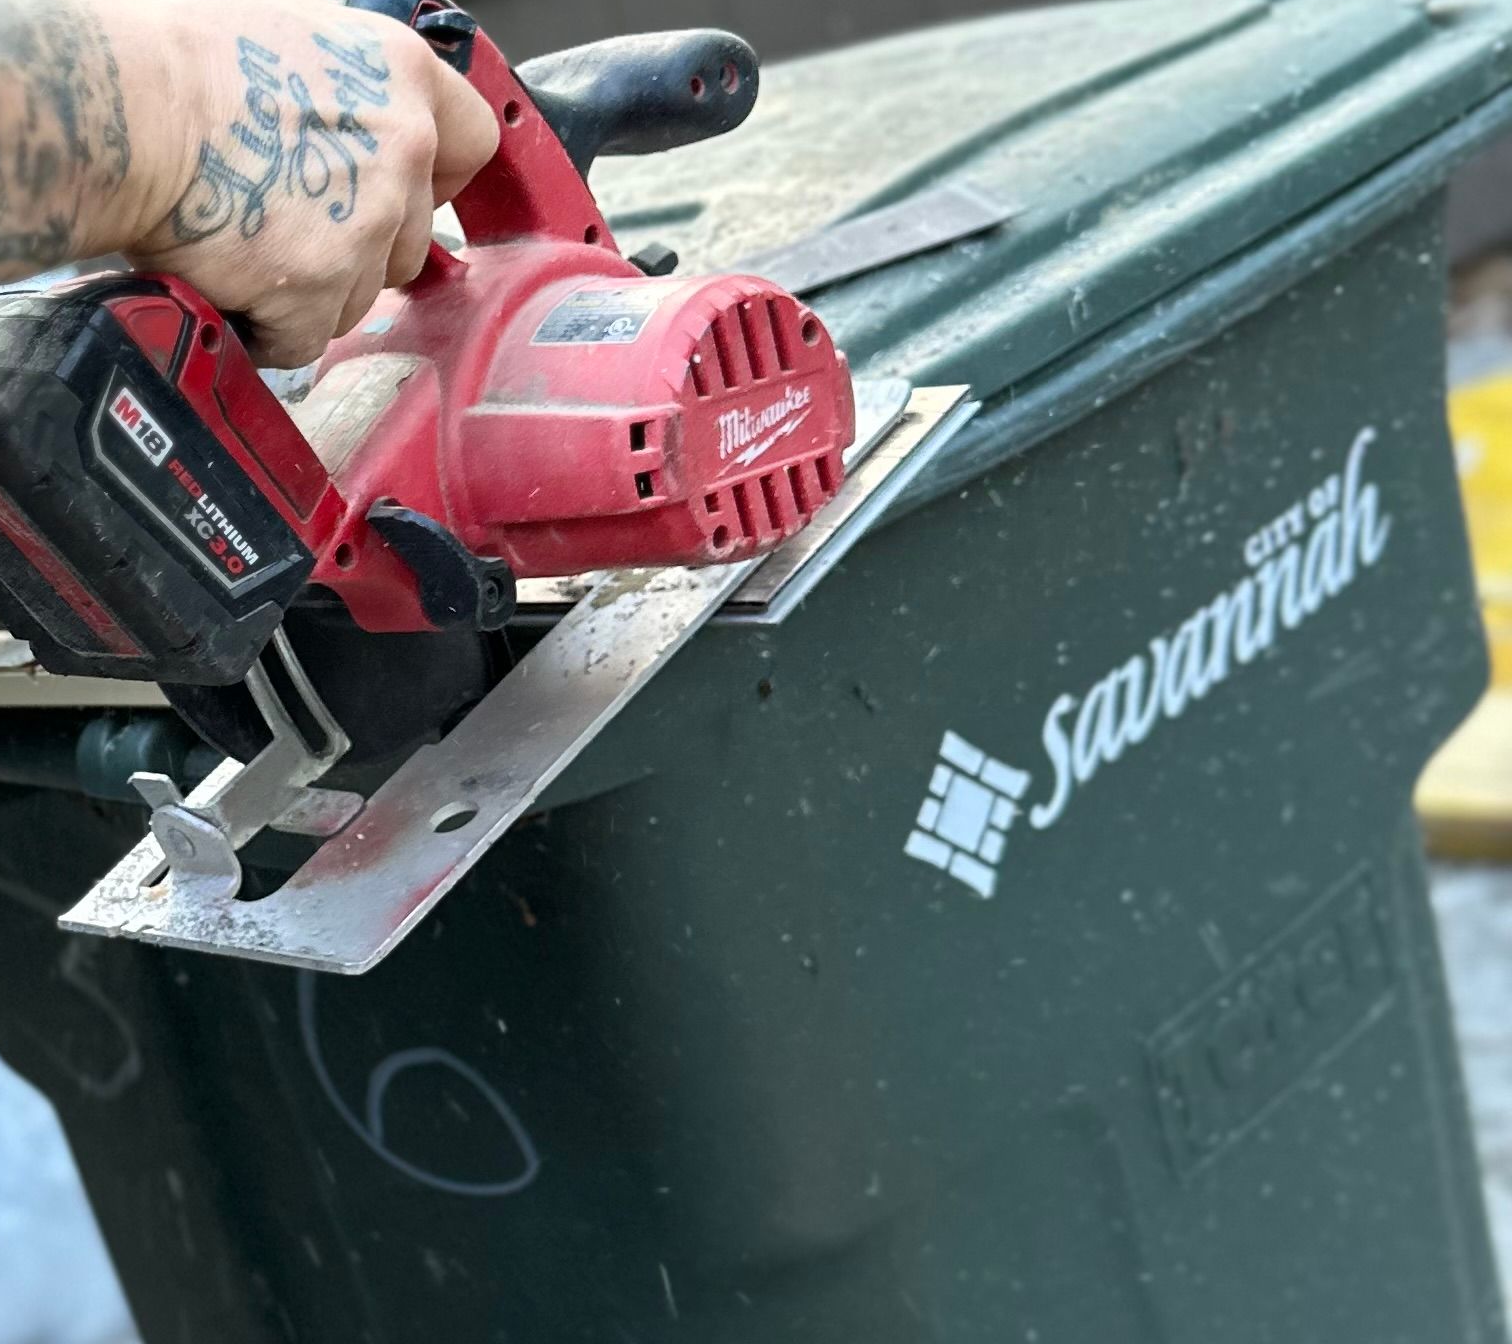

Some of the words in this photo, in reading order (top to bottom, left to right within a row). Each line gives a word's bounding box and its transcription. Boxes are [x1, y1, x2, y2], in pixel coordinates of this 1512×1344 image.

[114, 394, 168, 457] M18
[718, 385, 811, 460] Milwaukee
[167, 457, 260, 566] REDLITHIUM
[1243, 500, 1304, 568] CITY
[1029, 426, 1393, 830] Savannah
